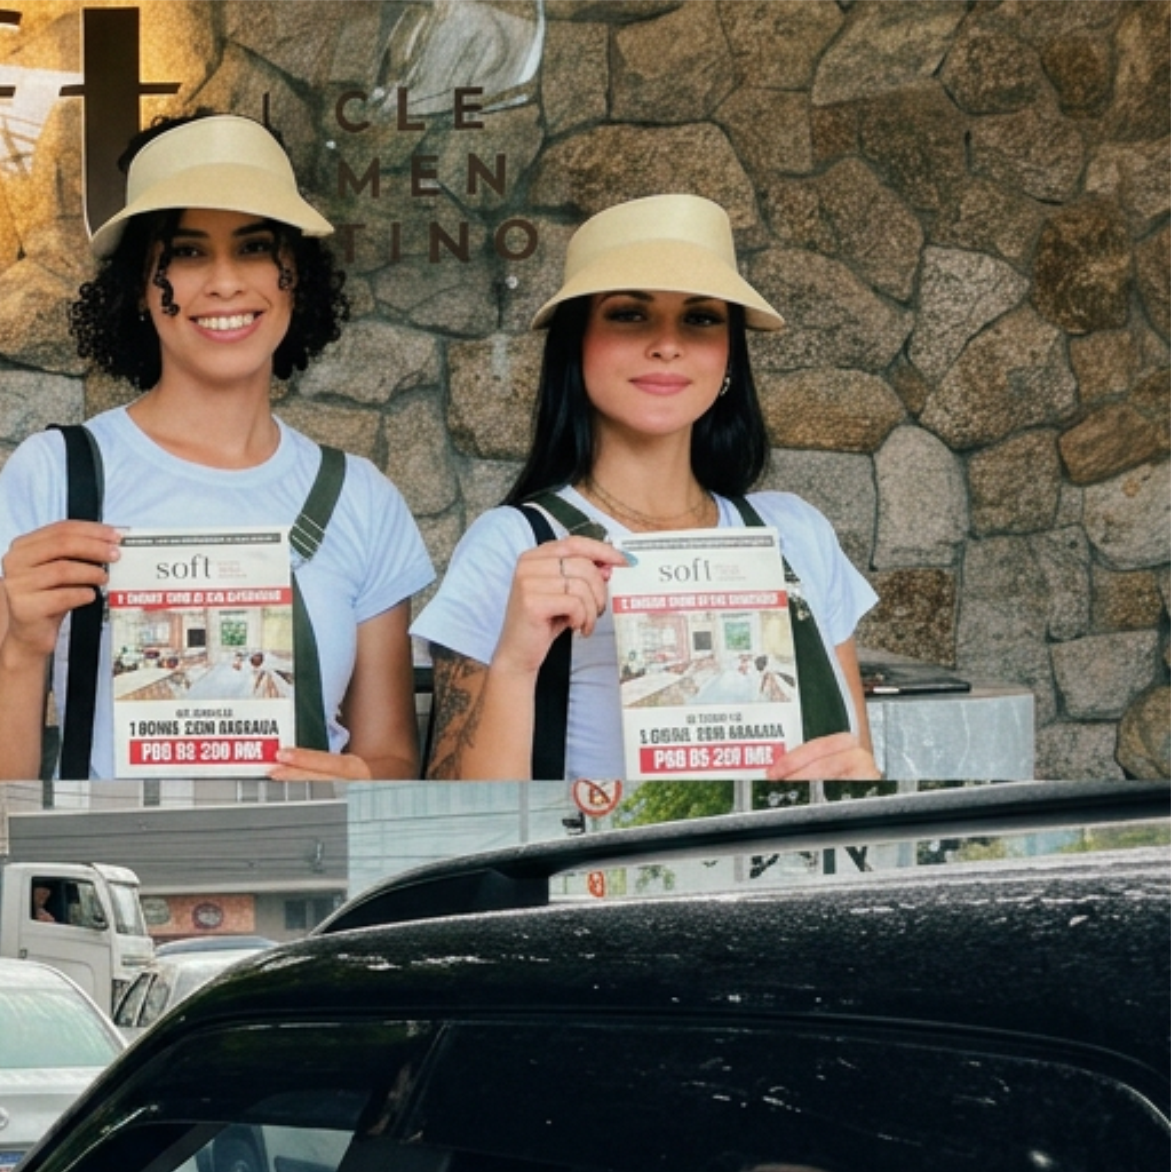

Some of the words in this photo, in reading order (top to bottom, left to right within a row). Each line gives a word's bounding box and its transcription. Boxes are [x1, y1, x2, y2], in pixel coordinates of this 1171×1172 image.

[335, 86, 484, 133] CLE
[337, 153, 506, 198] MEN
[338, 218, 539, 264] TINO
[156, 554, 211, 580] soft
